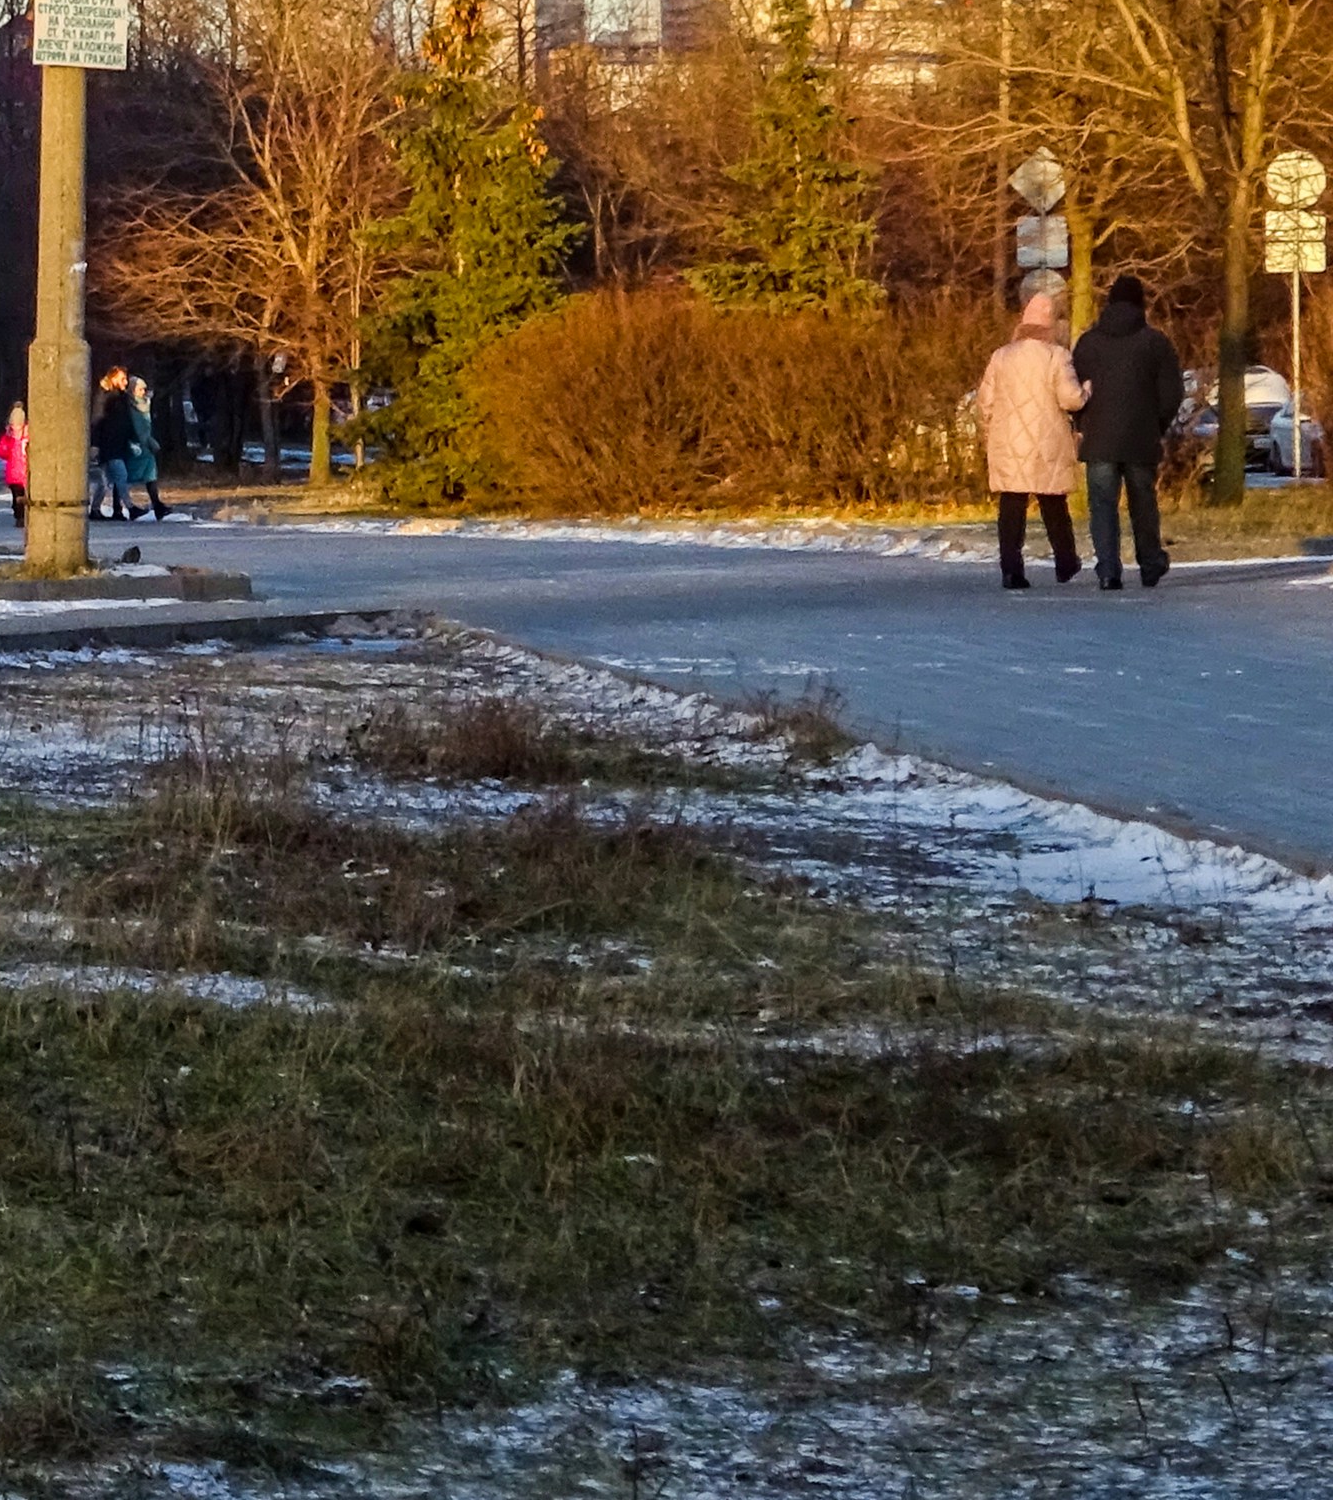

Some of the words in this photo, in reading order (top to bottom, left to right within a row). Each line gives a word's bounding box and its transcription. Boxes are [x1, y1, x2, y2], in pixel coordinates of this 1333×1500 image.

[38, 3, 69, 15] СТРОГО
[48, 16, 59, 26] НА
[70, 53, 80, 62] НА
